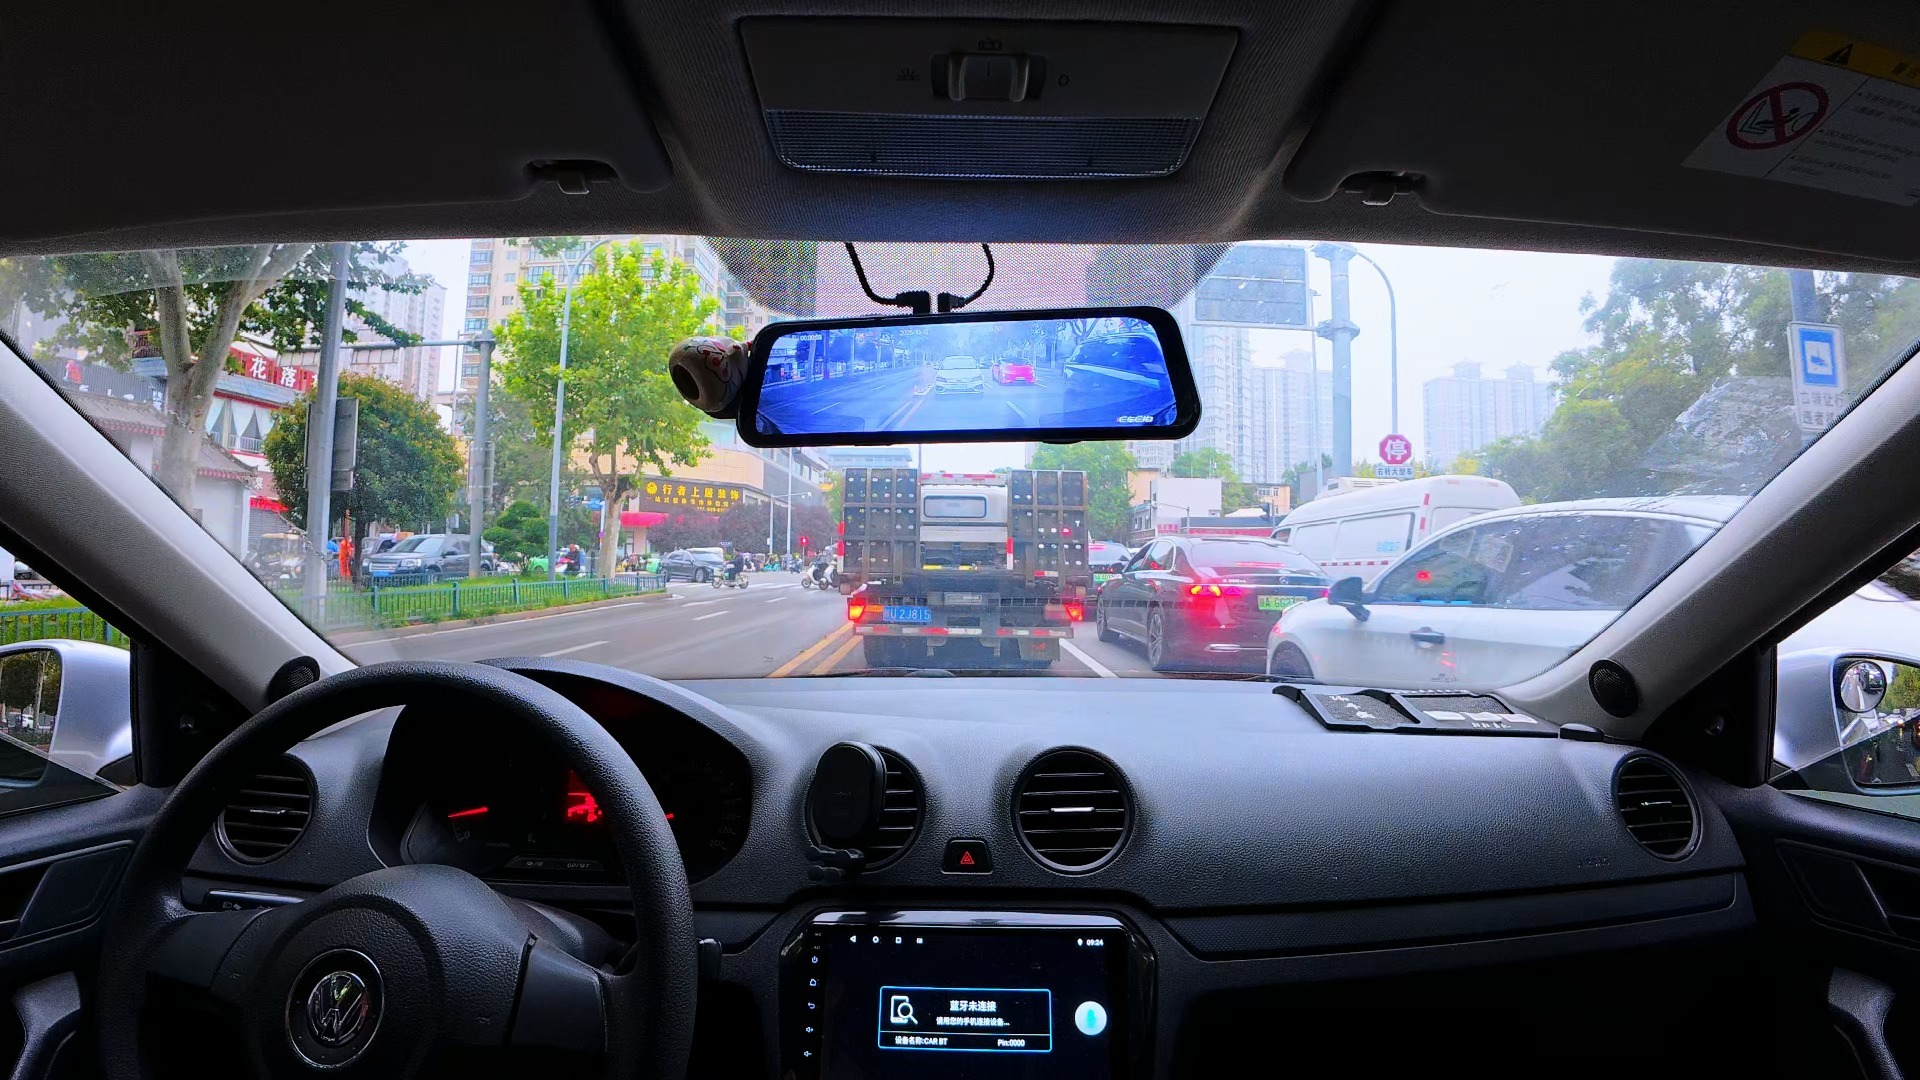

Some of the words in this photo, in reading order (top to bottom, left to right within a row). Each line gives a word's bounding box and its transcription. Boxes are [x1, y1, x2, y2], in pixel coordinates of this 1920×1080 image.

[1384, 439, 1408, 461] 停
[1377, 467, 1413, 476] 右转大型车
[885, 608, 930, 620] U2J815
[949, 1000, 997, 1012] 蓝牙未连接
[938, 1038, 948, 1046] BT
[997, 1039, 1026, 1047] Pin:0000
